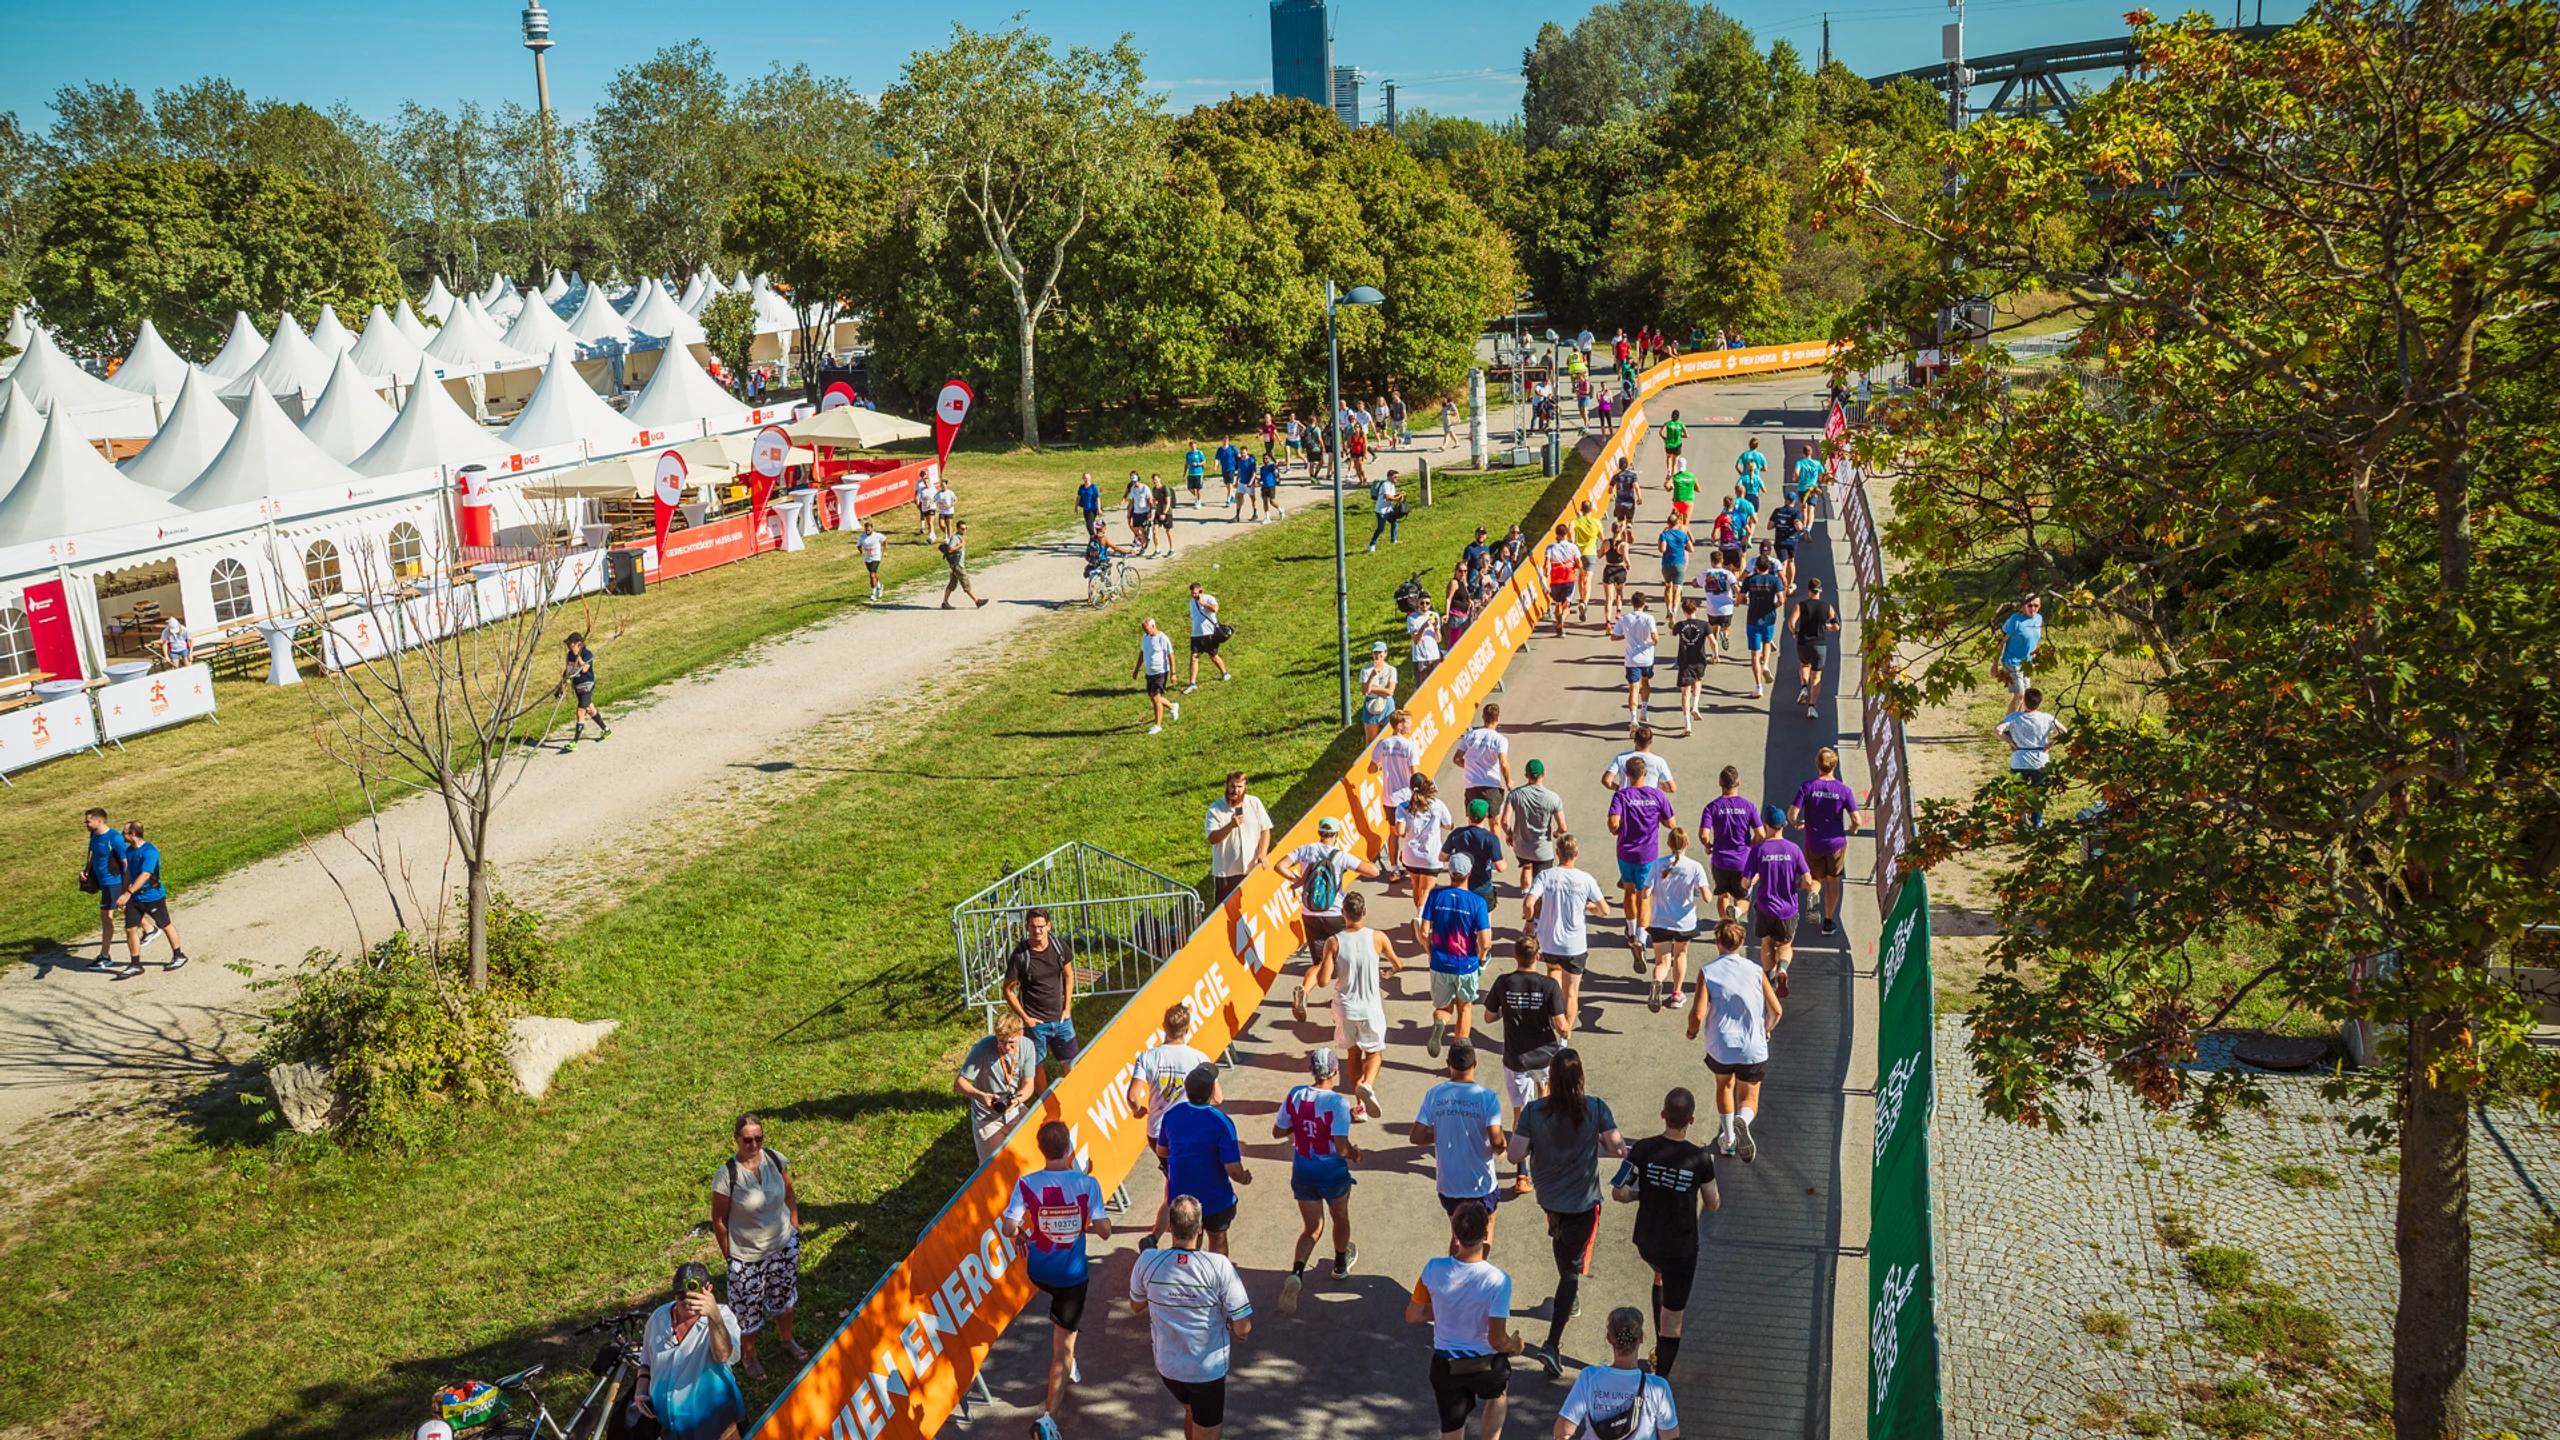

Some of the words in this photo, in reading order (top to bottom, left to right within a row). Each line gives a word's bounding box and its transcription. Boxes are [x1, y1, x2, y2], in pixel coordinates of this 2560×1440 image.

[1450, 667, 1474, 704] WIEN
[1468, 636, 1496, 683] ENERGIE
[1762, 853, 1791, 862] ACREDIA
